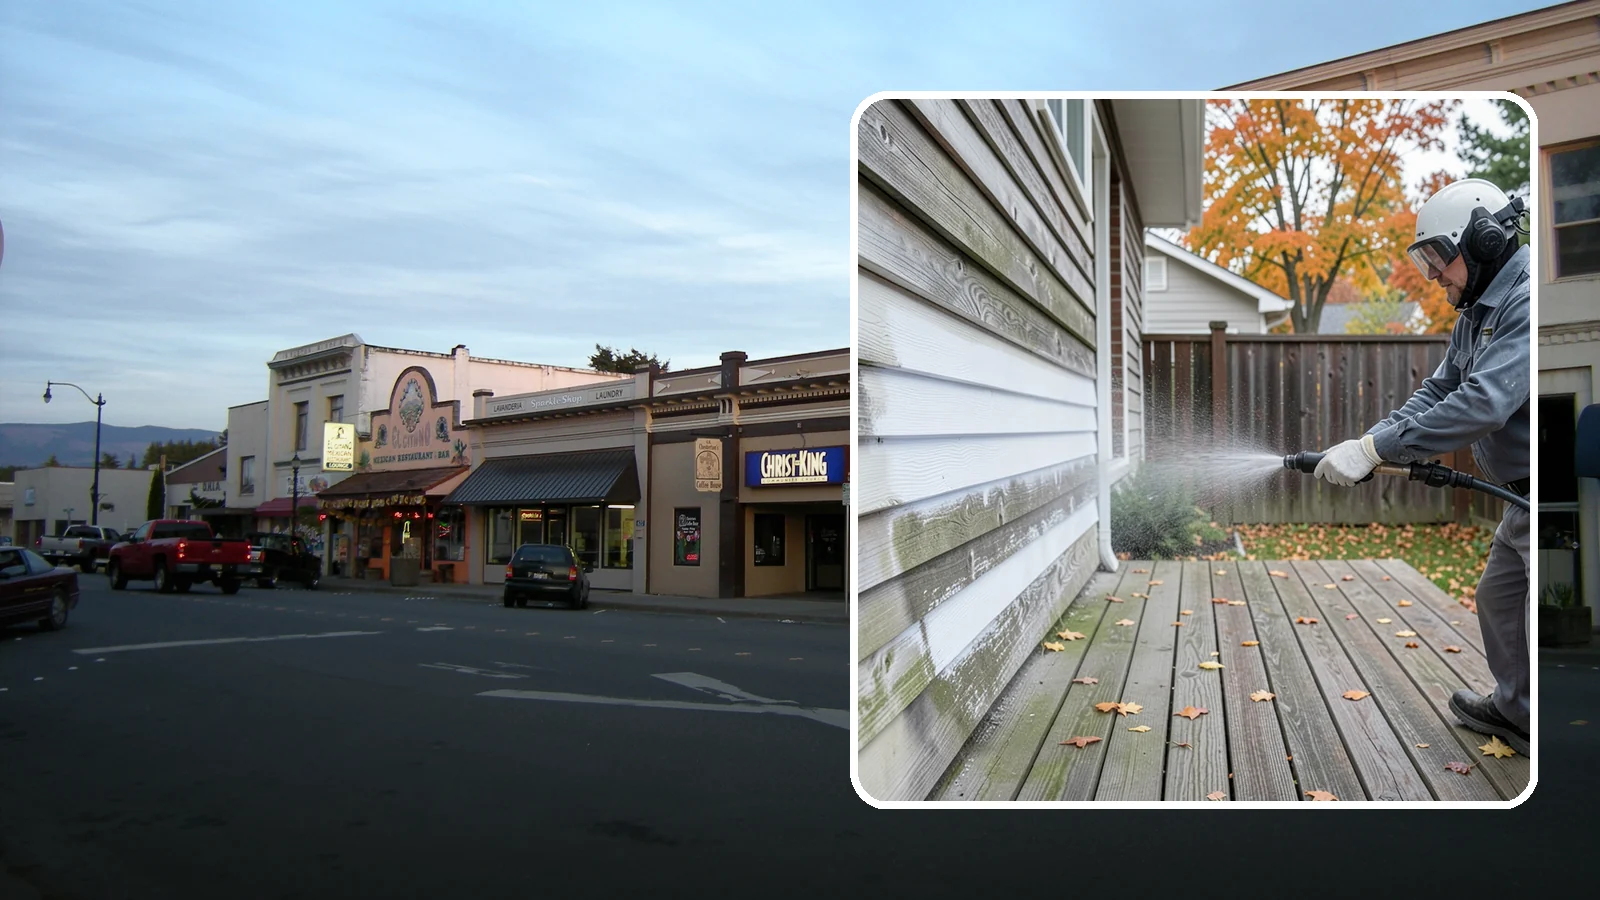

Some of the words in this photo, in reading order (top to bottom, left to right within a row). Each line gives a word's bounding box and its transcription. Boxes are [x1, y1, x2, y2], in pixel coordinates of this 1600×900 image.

[595, 389, 624, 399] LAUNDRY
[493, 401, 522, 412] LAVANDERIA
[530, 396, 560, 409] Sparkle
[562, 394, 582, 404] Shop
[392, 424, 401, 449] EL
[373, 454, 396, 464] MEXICAN
[397, 451, 433, 462] RESTAURANT
[438, 450, 450, 459] BAR
[761, 452, 797, 478] CHRIST
[799, 450, 827, 476] KING
